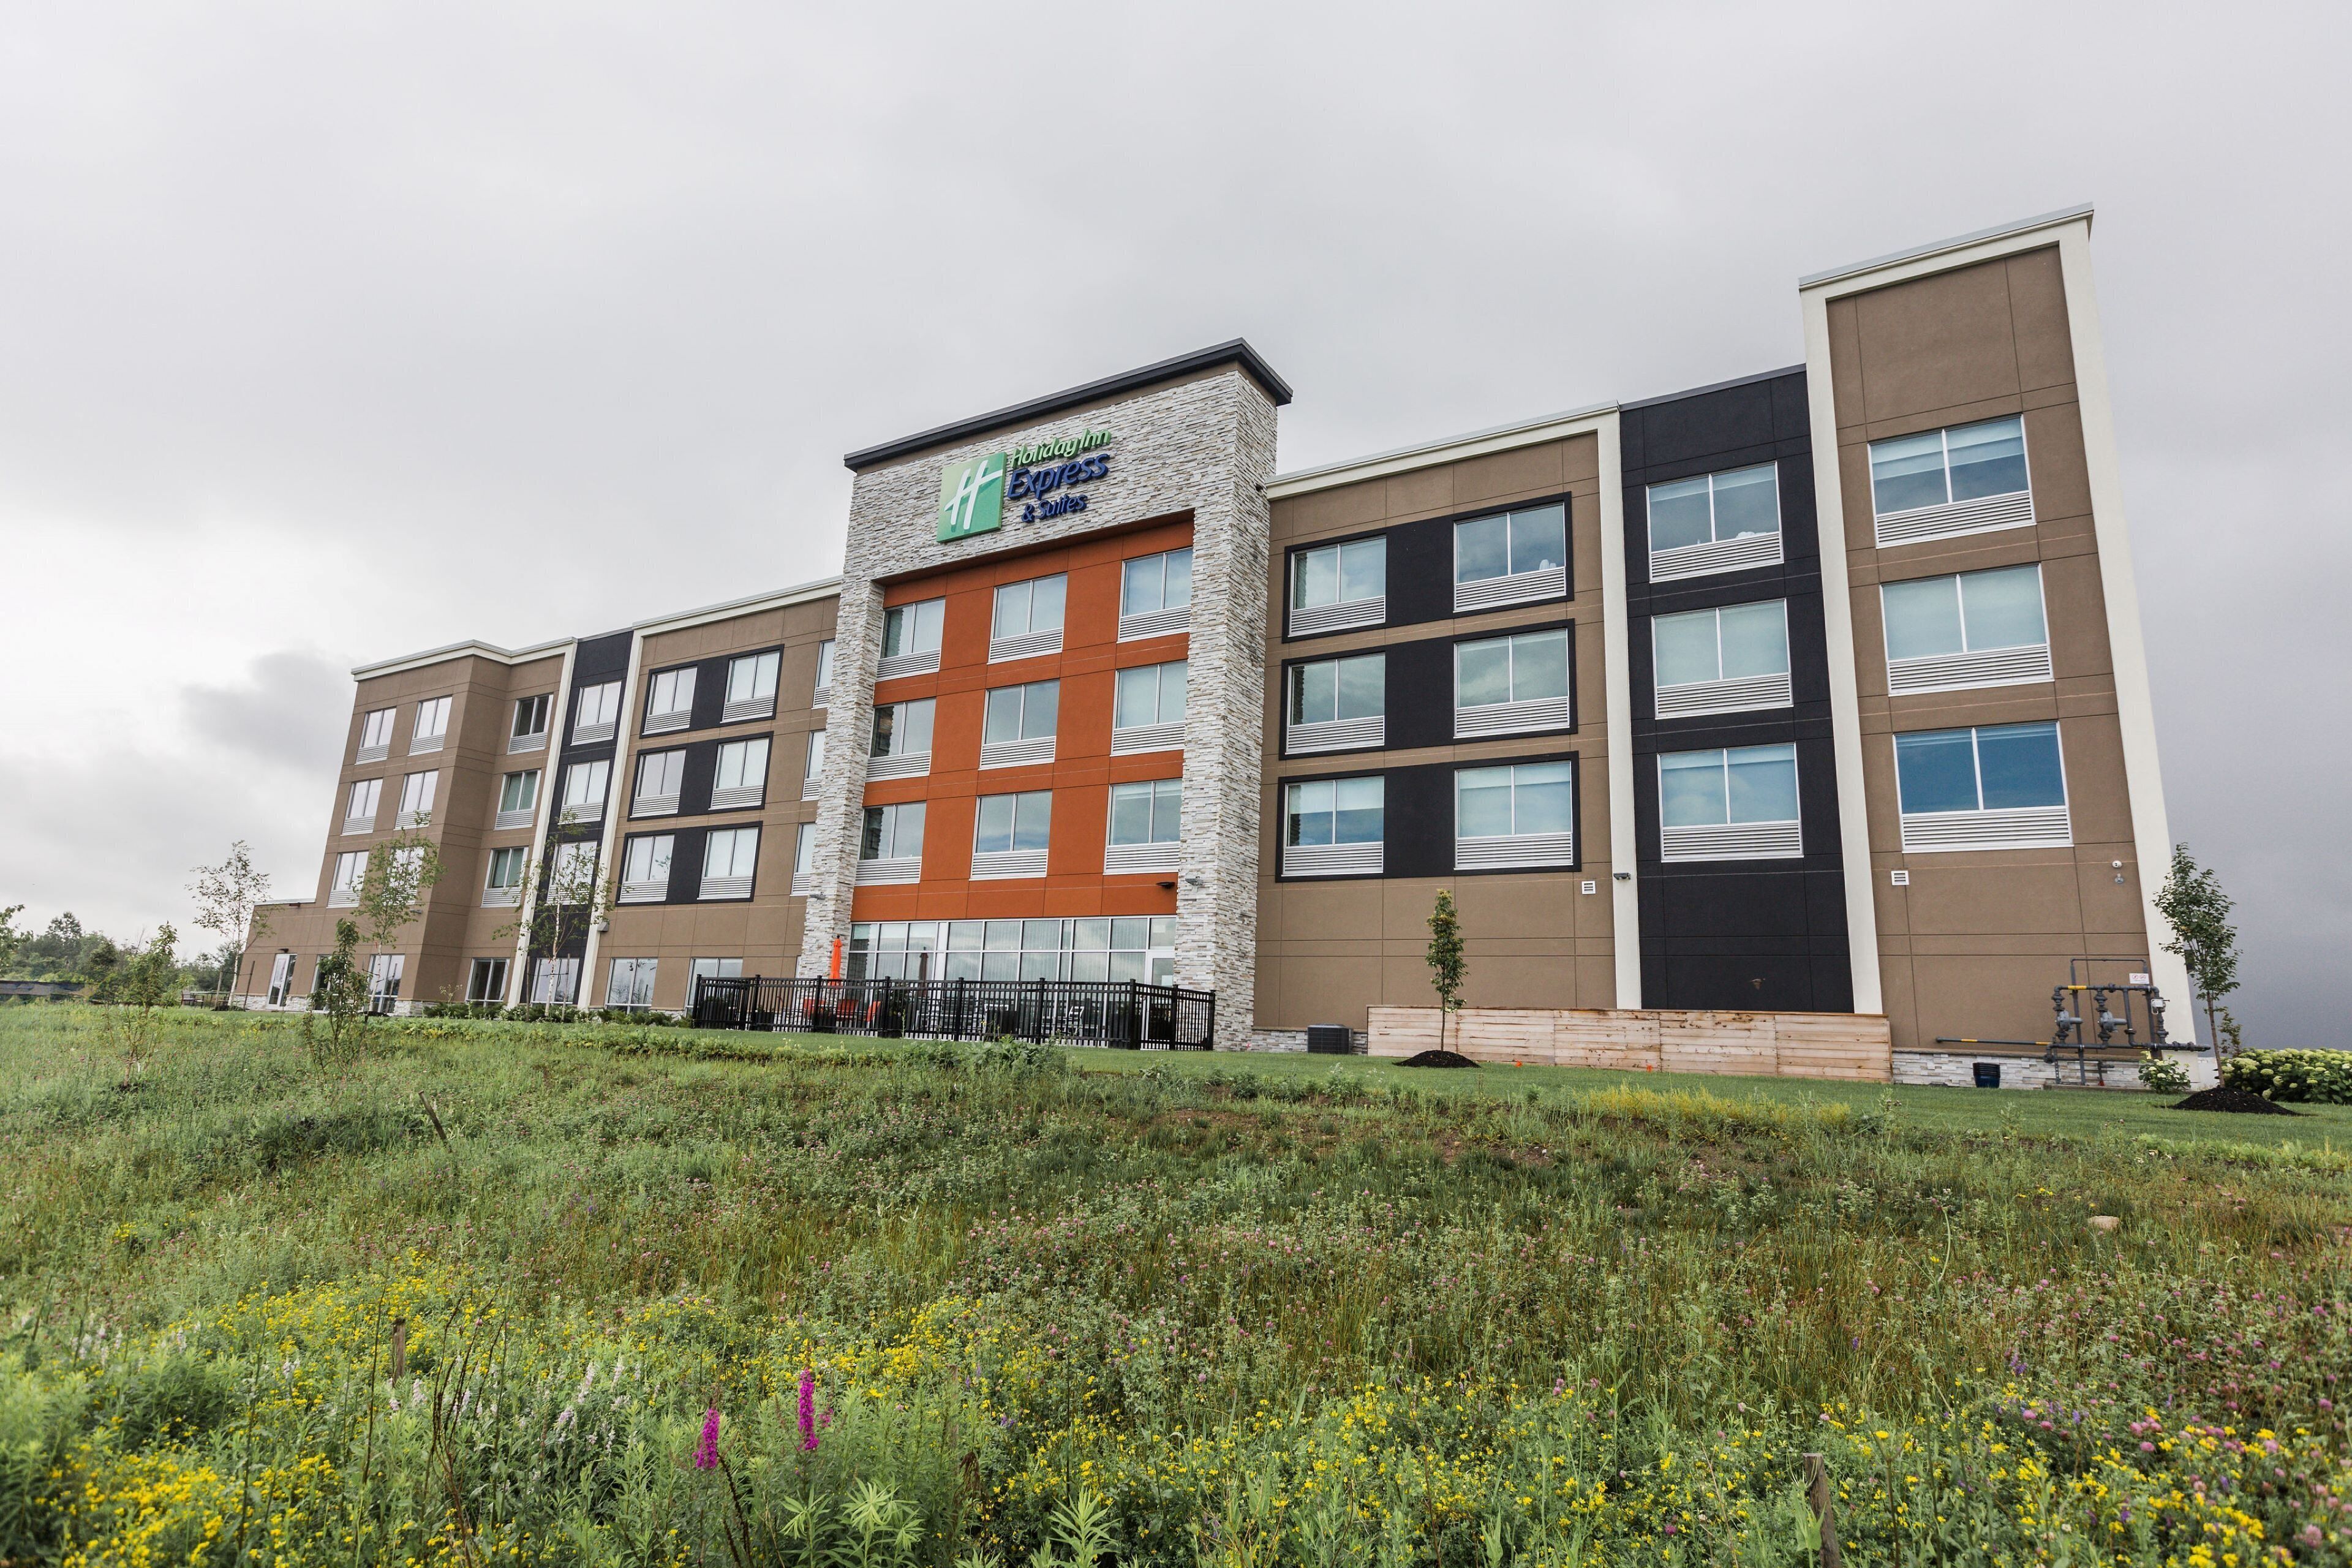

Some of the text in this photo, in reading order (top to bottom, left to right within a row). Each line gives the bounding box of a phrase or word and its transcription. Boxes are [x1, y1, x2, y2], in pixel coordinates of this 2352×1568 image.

[1011, 428, 1112, 469] Holiday Inn
[1007, 453, 1110, 500] Express
[1021, 494, 1088, 522] & Suites
